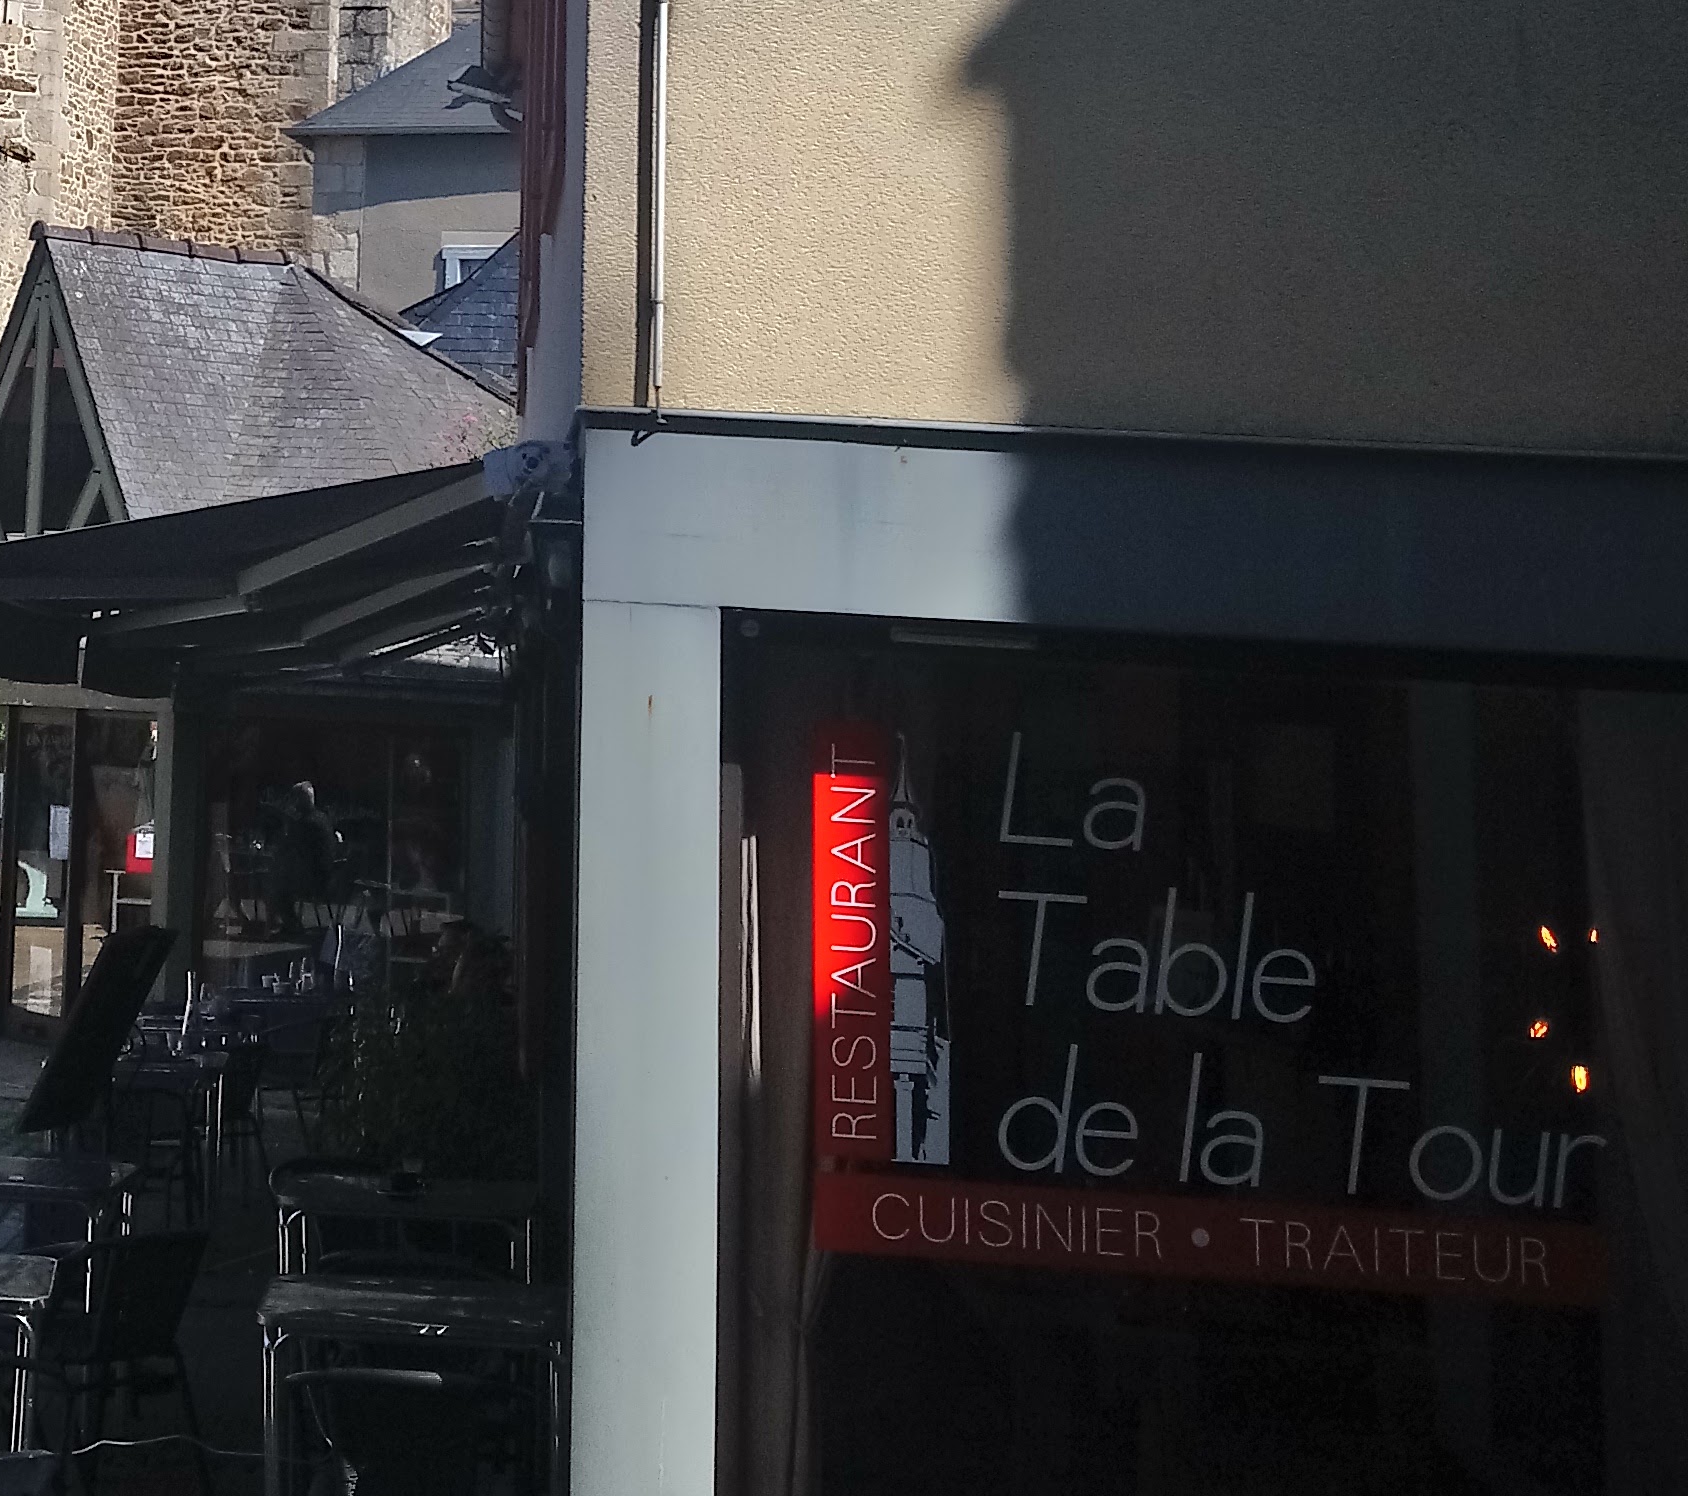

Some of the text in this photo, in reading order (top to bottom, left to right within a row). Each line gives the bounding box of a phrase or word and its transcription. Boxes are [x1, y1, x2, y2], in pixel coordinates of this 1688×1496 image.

[999, 731, 1146, 852] La
[829, 743, 878, 1140] RESTAURANT
[998, 886, 1317, 1023] Table
[997, 1043, 1608, 1209] de la Tour
[872, 1192, 1551, 1288] CUISINIER TRAITEUR
